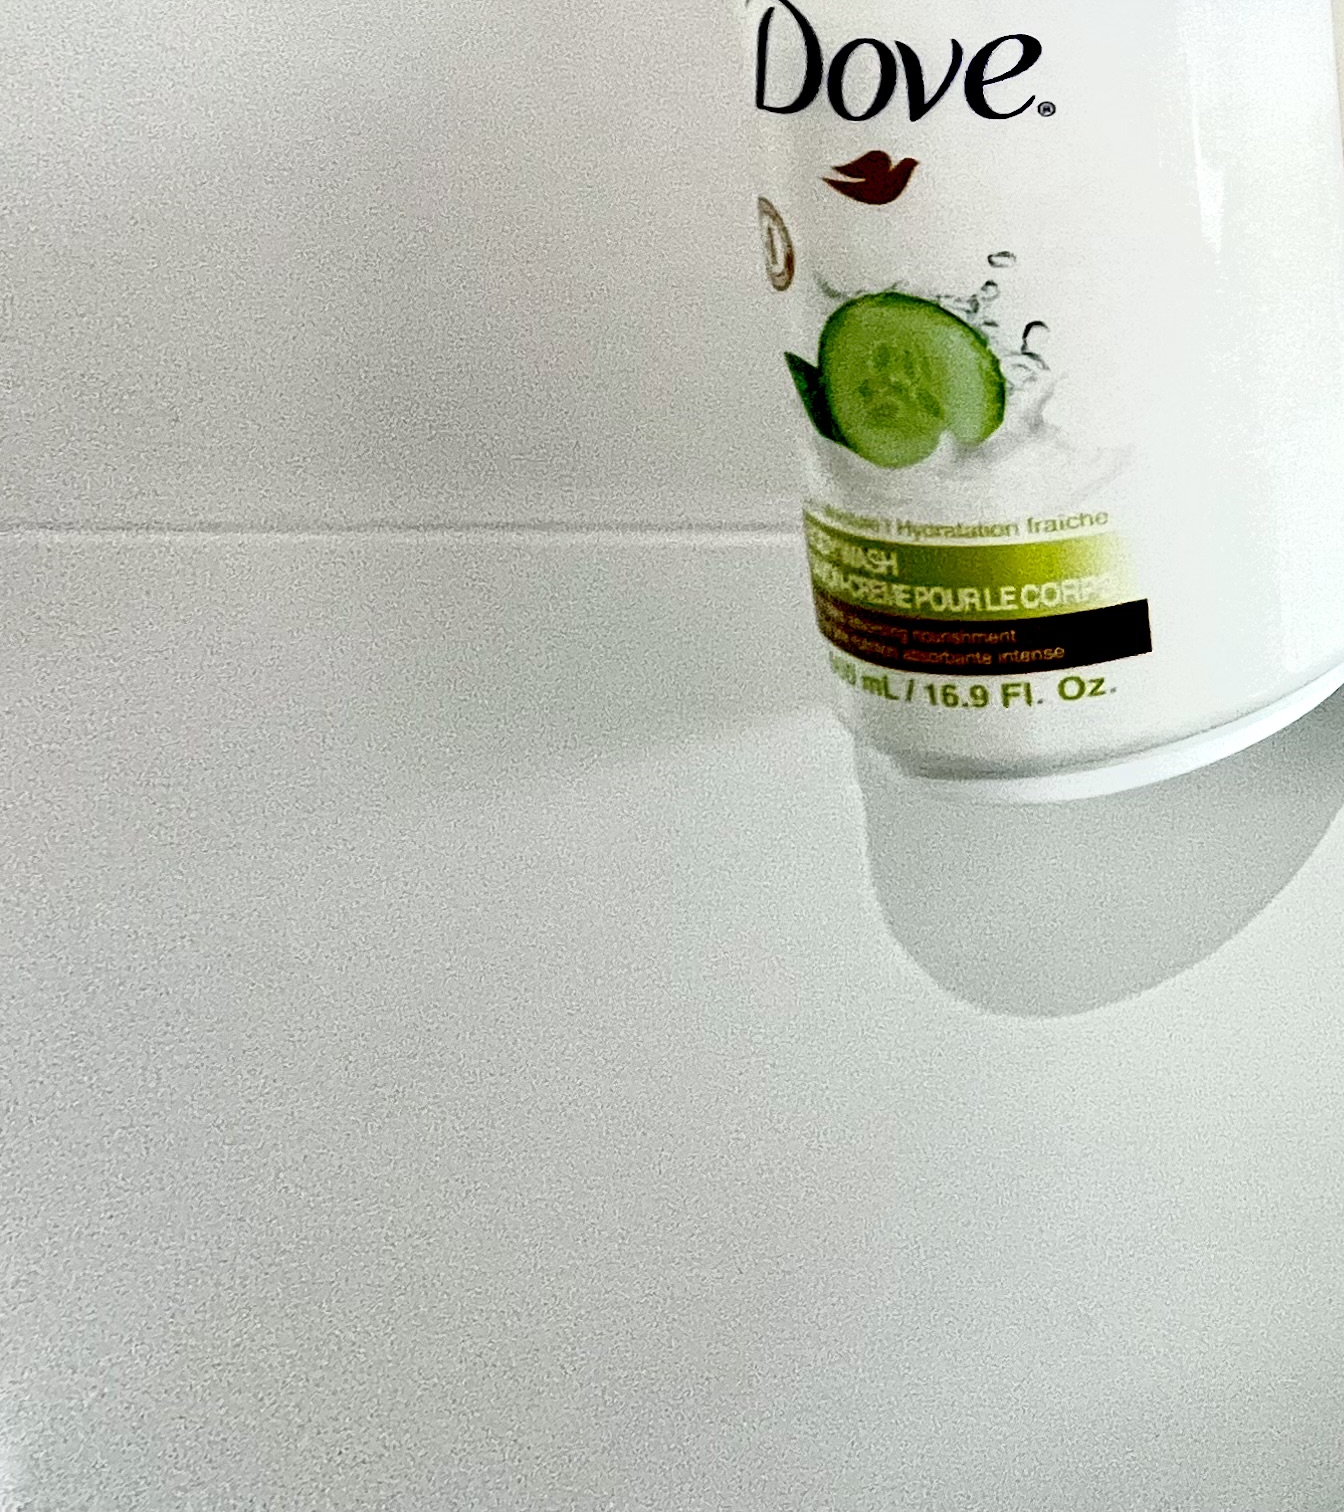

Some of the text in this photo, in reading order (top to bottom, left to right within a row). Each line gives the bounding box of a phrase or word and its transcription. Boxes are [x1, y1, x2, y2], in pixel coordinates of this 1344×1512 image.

[914, 585, 982, 613] POUR
[985, 585, 1018, 612] LE
[998, 646, 1066, 665] intense
[860, 672, 900, 701] mL
[924, 682, 990, 709] 16.9
[1000, 681, 1044, 709] Fl.
[1057, 675, 1118, 702] Oz.
